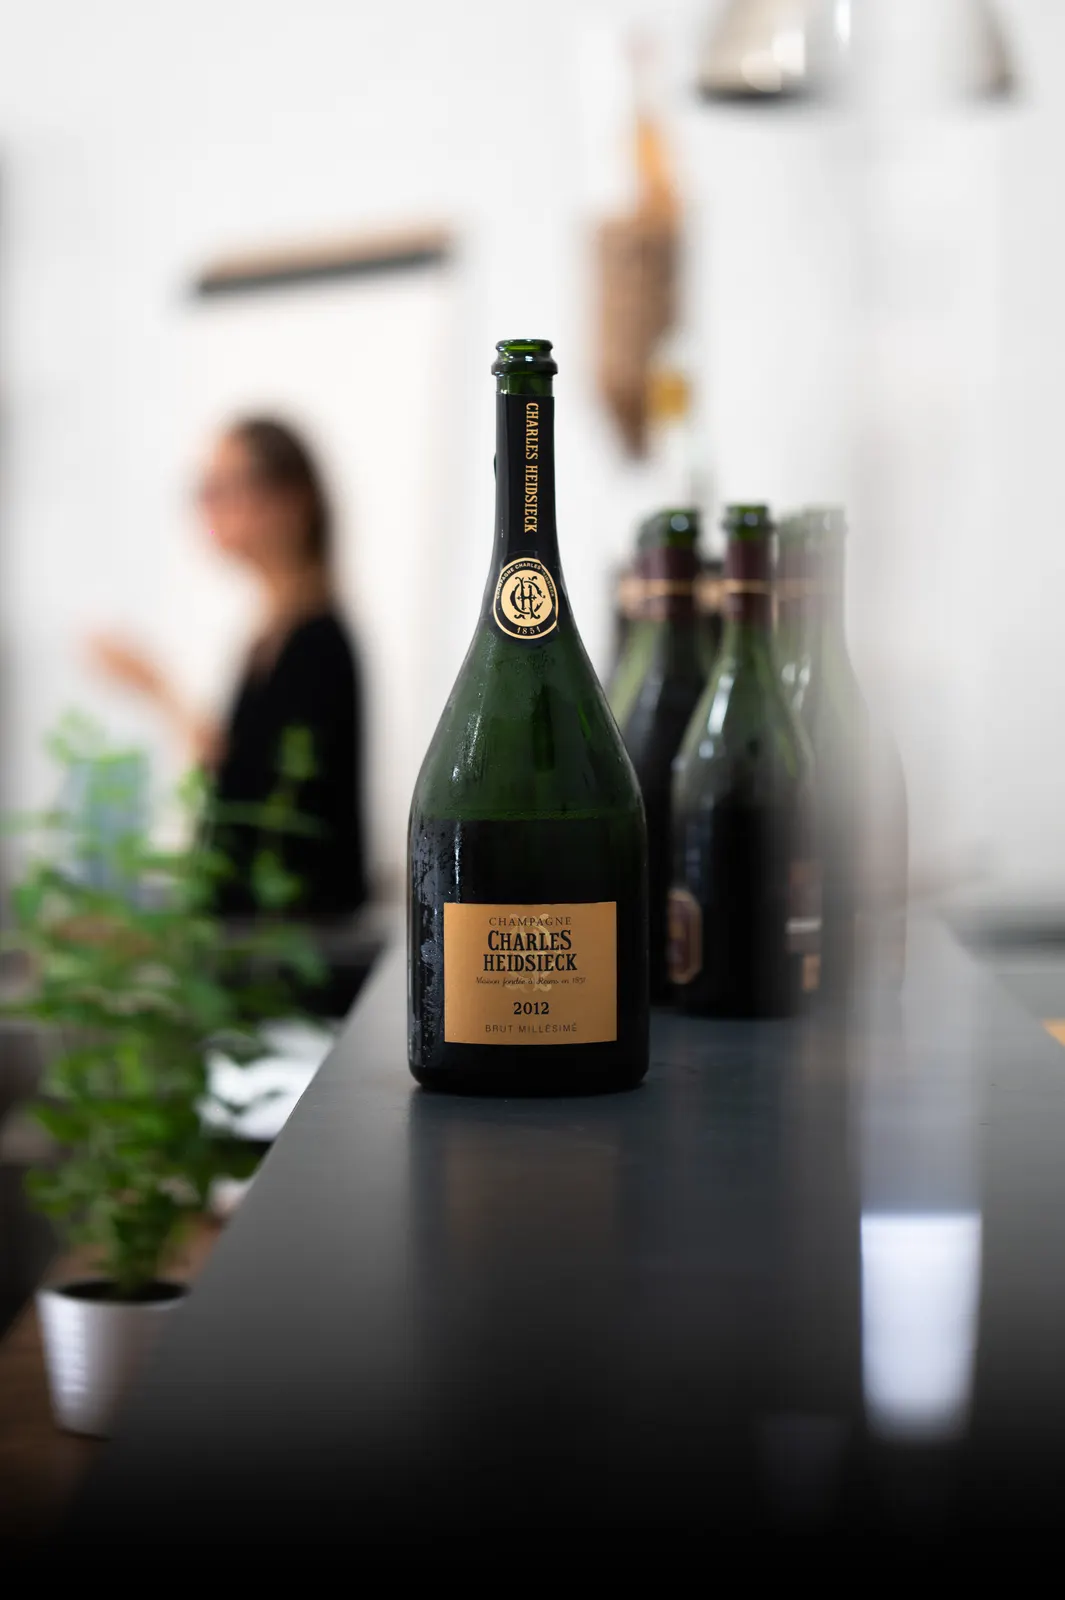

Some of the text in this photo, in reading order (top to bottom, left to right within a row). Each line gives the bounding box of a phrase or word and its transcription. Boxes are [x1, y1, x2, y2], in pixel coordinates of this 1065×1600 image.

[524, 402, 539, 533] CHARLES HEIDSIECK
[514, 562, 541, 571] CHARLES
[516, 625, 541, 635] 1851
[488, 916, 572, 926] CHAMPAGNE
[487, 929, 572, 951] CHARLES
[483, 953, 578, 972] HEIDSIECK
[513, 1001, 550, 1015] 2012
[485, 1024, 514, 1033] BRUT
